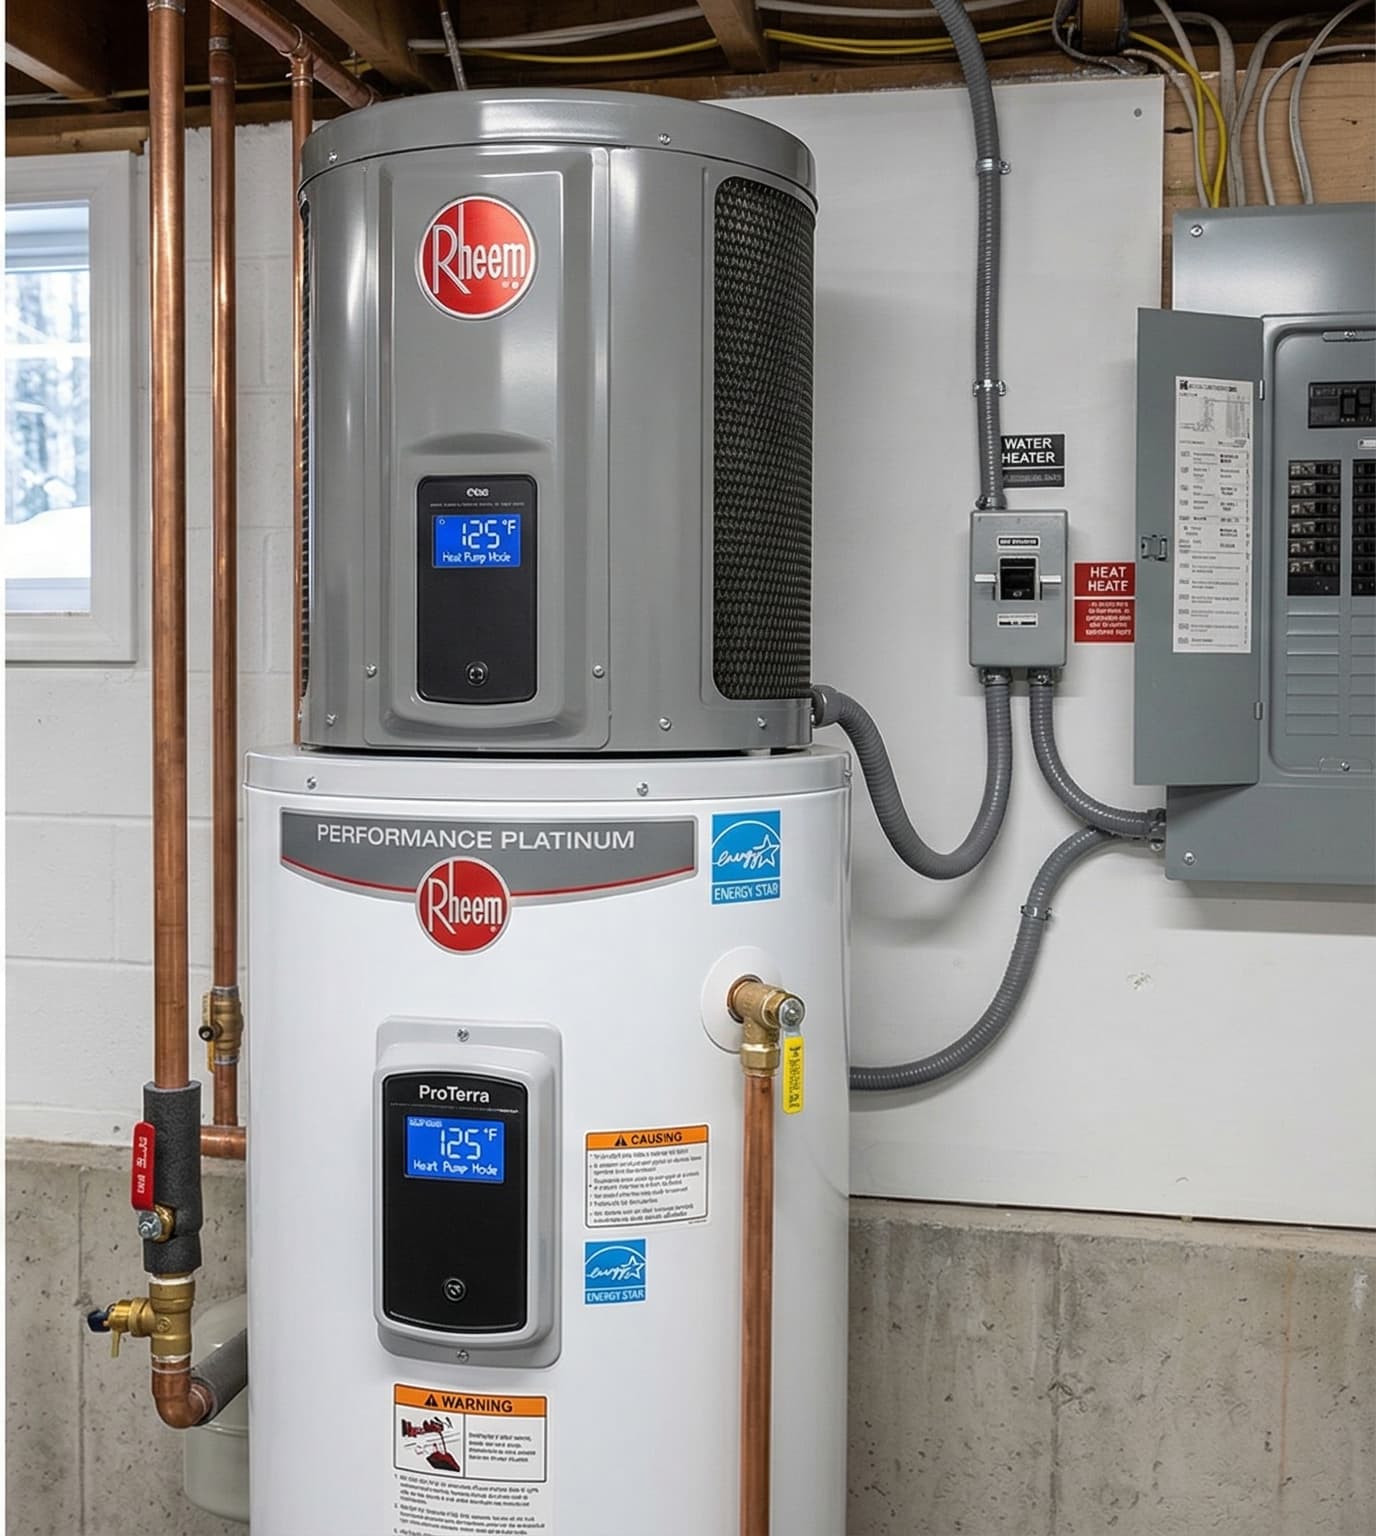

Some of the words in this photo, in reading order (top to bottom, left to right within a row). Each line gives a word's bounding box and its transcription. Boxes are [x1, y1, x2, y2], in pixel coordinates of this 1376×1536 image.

[432, 203, 526, 295] Rheem
[1004, 437, 1052, 450] WATER
[1001, 451, 1056, 464] HEATER
[1090, 566, 1128, 578] HEAT
[317, 823, 493, 849] PERFORMANCE
[500, 830, 635, 849] PLATINUM
[427, 860, 503, 935] Rheem
[714, 885, 753, 901] ENERGY
[418, 1084, 490, 1103] ProTerra
[630, 1131, 683, 1145] CAUSING
[442, 1395, 513, 1413] WARNING
